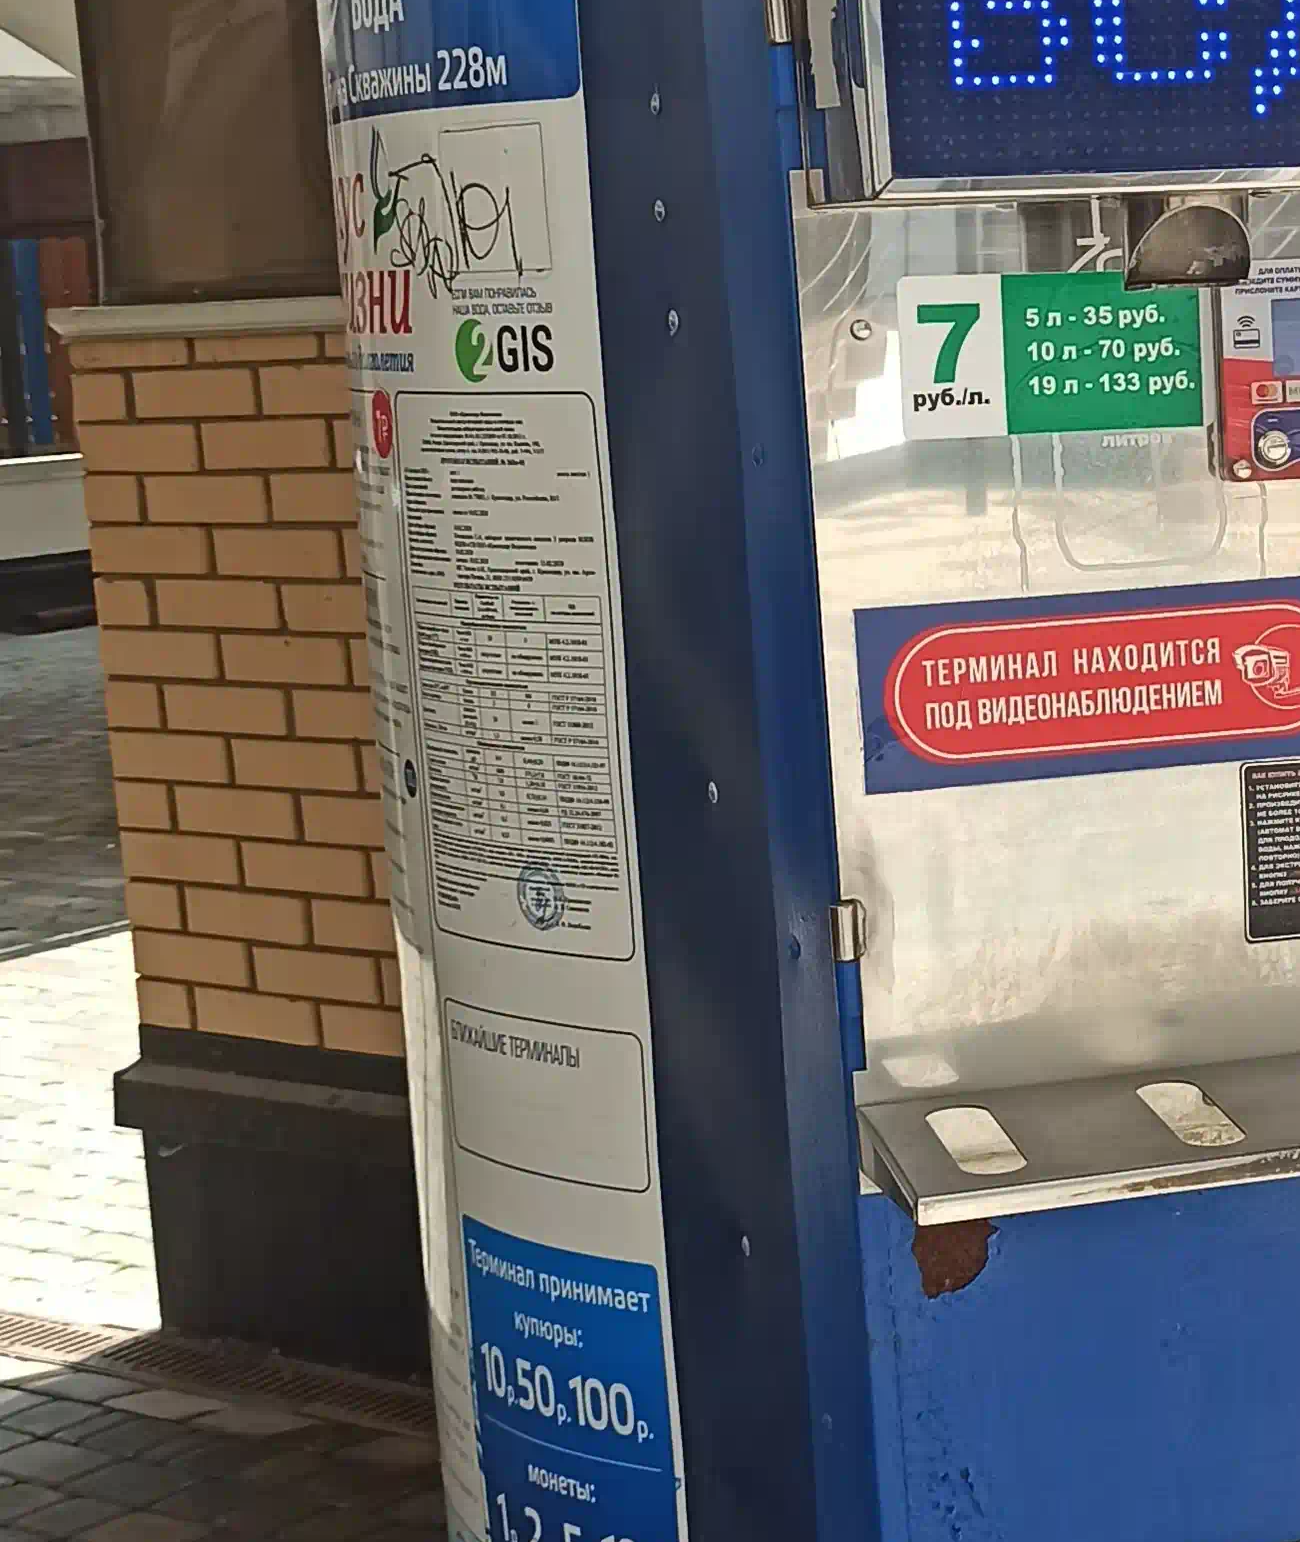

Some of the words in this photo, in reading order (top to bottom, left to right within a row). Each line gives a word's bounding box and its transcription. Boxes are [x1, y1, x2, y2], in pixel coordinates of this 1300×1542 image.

[436, 45, 508, 92] 228м
[1024, 308, 1040, 328] 5
[1046, 310, 1063, 327] л
[1082, 306, 1113, 326] 35
[1117, 303, 1166, 330] руб.
[916, 303, 981, 385] 7
[1027, 341, 1055, 361] 10
[1061, 343, 1078, 360] л
[1098, 339, 1126, 359] 70
[1133, 336, 1181, 363] руб.
[912, 388, 992, 412] руб./л.
[1028, 375, 1057, 396] 19
[1063, 377, 1080, 394] л
[1098, 372, 1141, 393] 133
[1148, 370, 1196, 396] руб.
[922, 649, 1058, 688] ТЕРМИНАЛ
[1072, 636, 1222, 676] НАХОДИТСЯ
[925, 700, 973, 731] ПОД
[977, 678, 1224, 726] ВИДЕОНАБЛЮДЕНИЕМ
[508, 1034, 581, 1070] ТЕРМИНАЛЫ
[467, 1236, 536, 1291] Терминал
[537, 1269, 651, 1315] принимает
[513, 1310, 585, 1350] купюры:
[527, 1463, 597, 1505] монеты:
